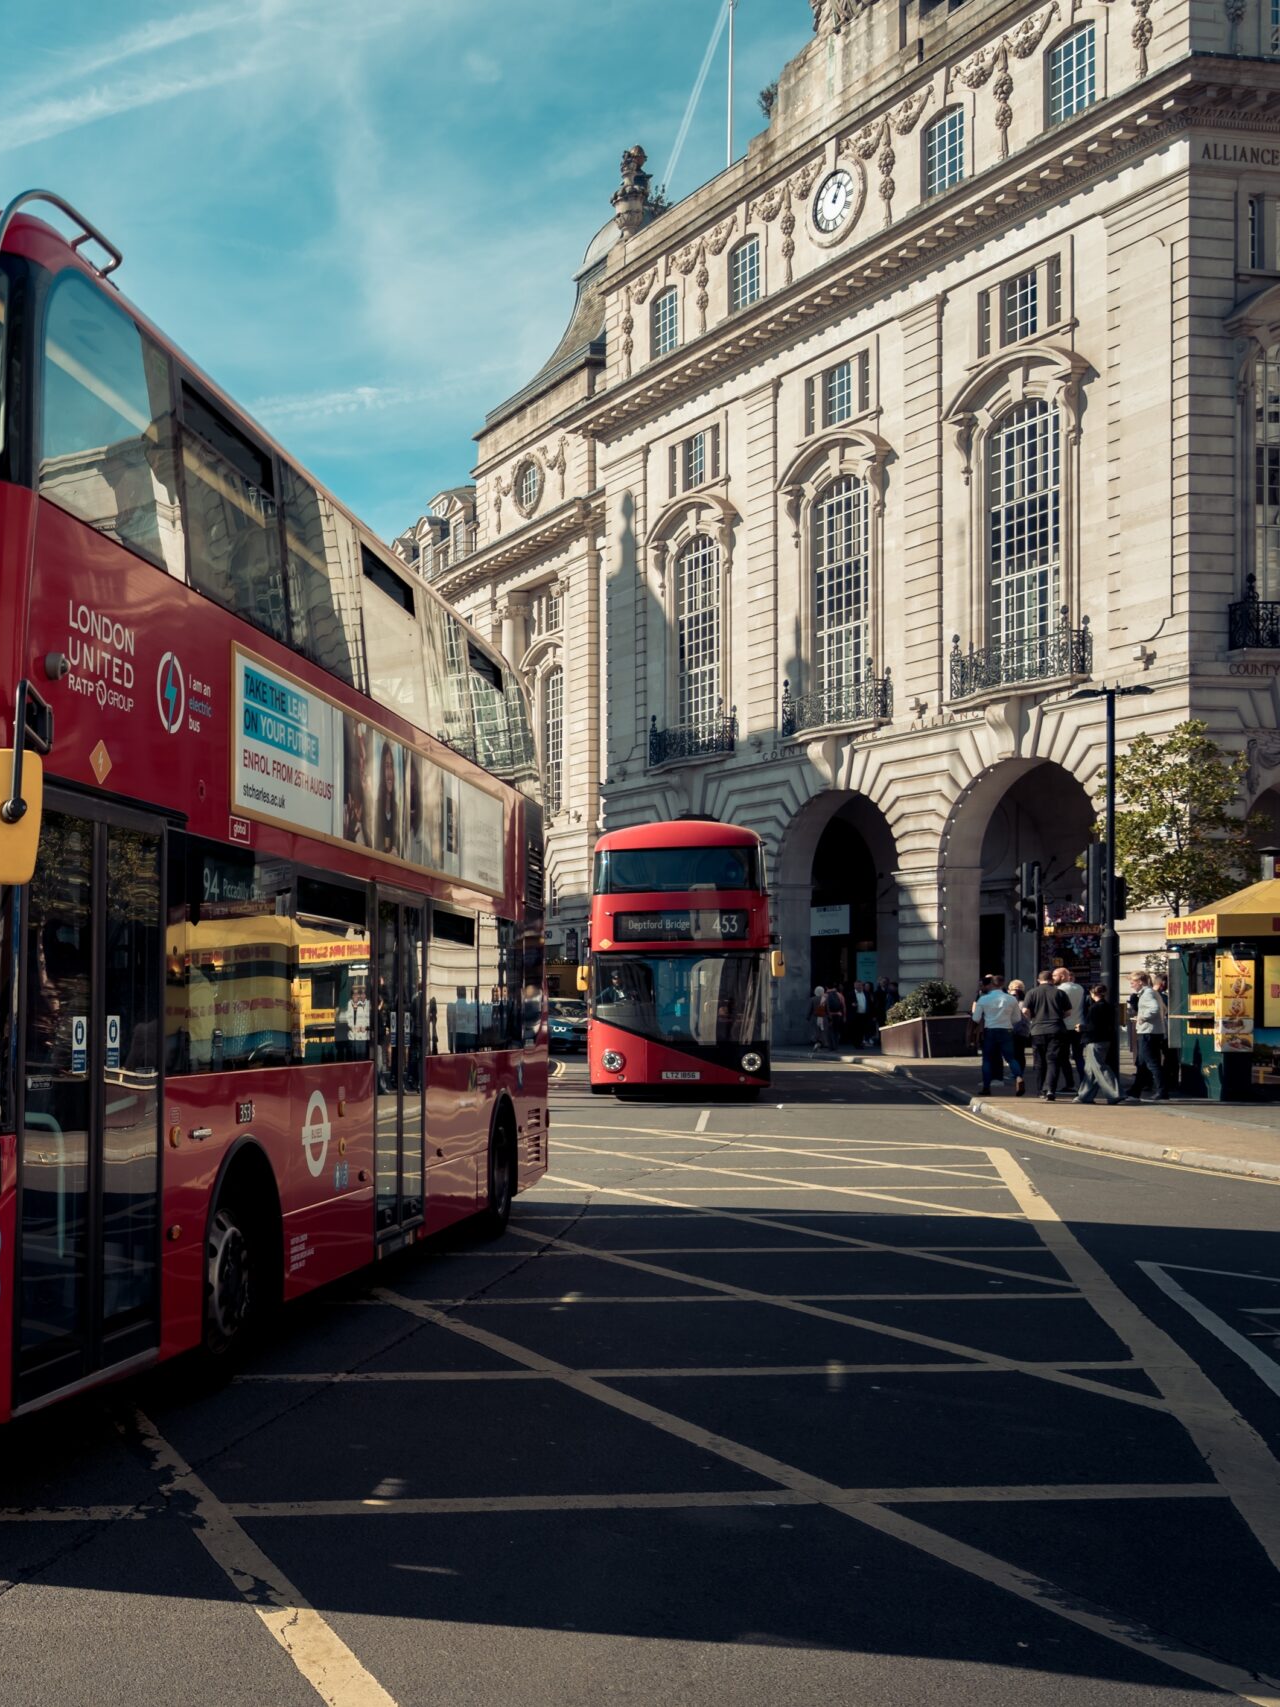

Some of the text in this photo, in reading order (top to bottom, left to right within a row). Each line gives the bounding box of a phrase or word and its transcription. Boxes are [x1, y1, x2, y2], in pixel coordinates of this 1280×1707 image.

[1202, 143, 1280, 166] ALLIANCE
[69, 599, 135, 657] LONDON
[69, 636, 134, 689] UNITED
[1229, 663, 1280, 676] COUNTY
[68, 673, 134, 713] RATP GROUP
[192, 678, 202, 693] am
[203, 683, 211, 698] an
[244, 674, 308, 724] TAKE THE LEAD
[188, 696, 212, 718] electric
[188, 715, 200, 733] bus
[910, 710, 978, 731] ALLIANC
[243, 708, 317, 760] ON YOUR FUTURE
[762, 744, 804, 762] COUNT
[243, 748, 270, 776] ENROL
[272, 759, 293, 785] FROM
[294, 769, 309, 791] 25TH
[243, 782, 286, 810] stcharles.ac.uk
[203, 867, 220, 902] 94
[628, 919, 690, 933] Deptford Bridge
[711, 914, 738, 933] 453
[1168, 918, 1215, 936] HOT DOG SPOT
[239, 1103, 251, 1122] 353
